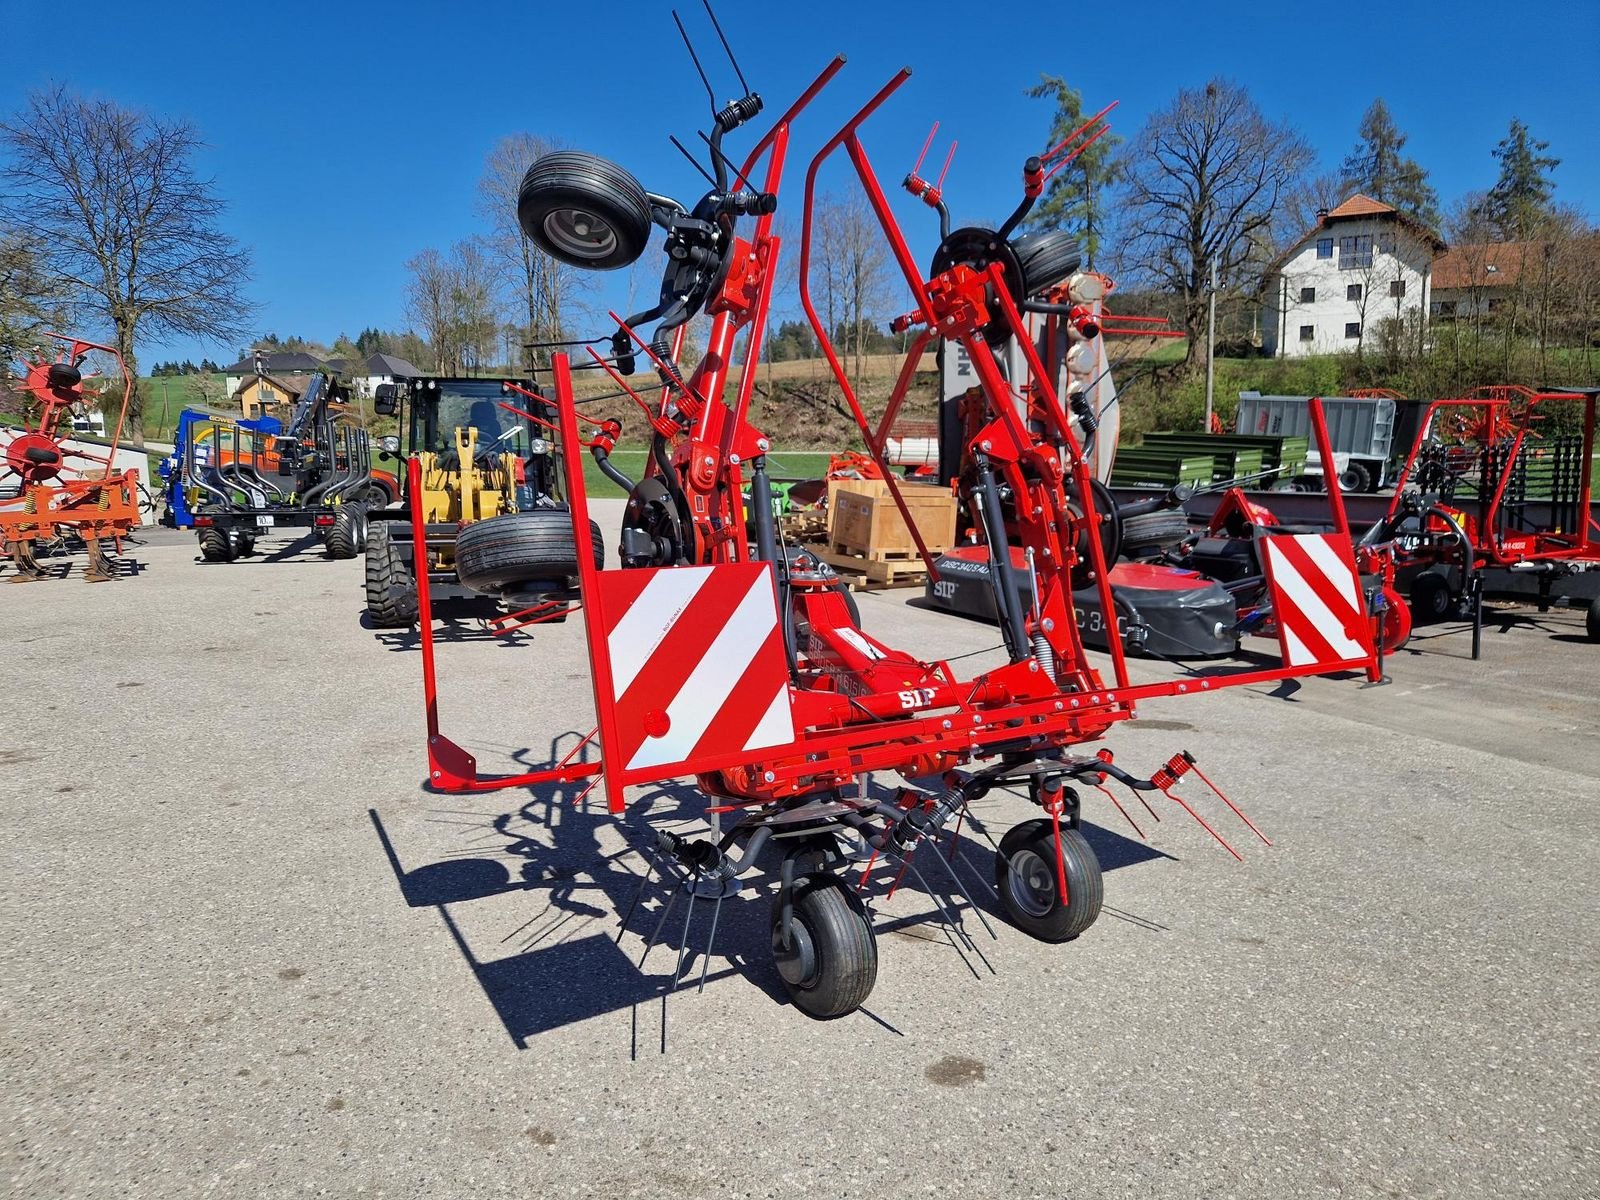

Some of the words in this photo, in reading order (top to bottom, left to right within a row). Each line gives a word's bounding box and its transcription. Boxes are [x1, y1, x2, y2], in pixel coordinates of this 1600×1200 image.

[941, 560, 960, 569] DISC
[957, 563, 974, 572] 340
[933, 580, 955, 598] SIP
[809, 635, 824, 653] SIP
[897, 687, 936, 709] SIP
